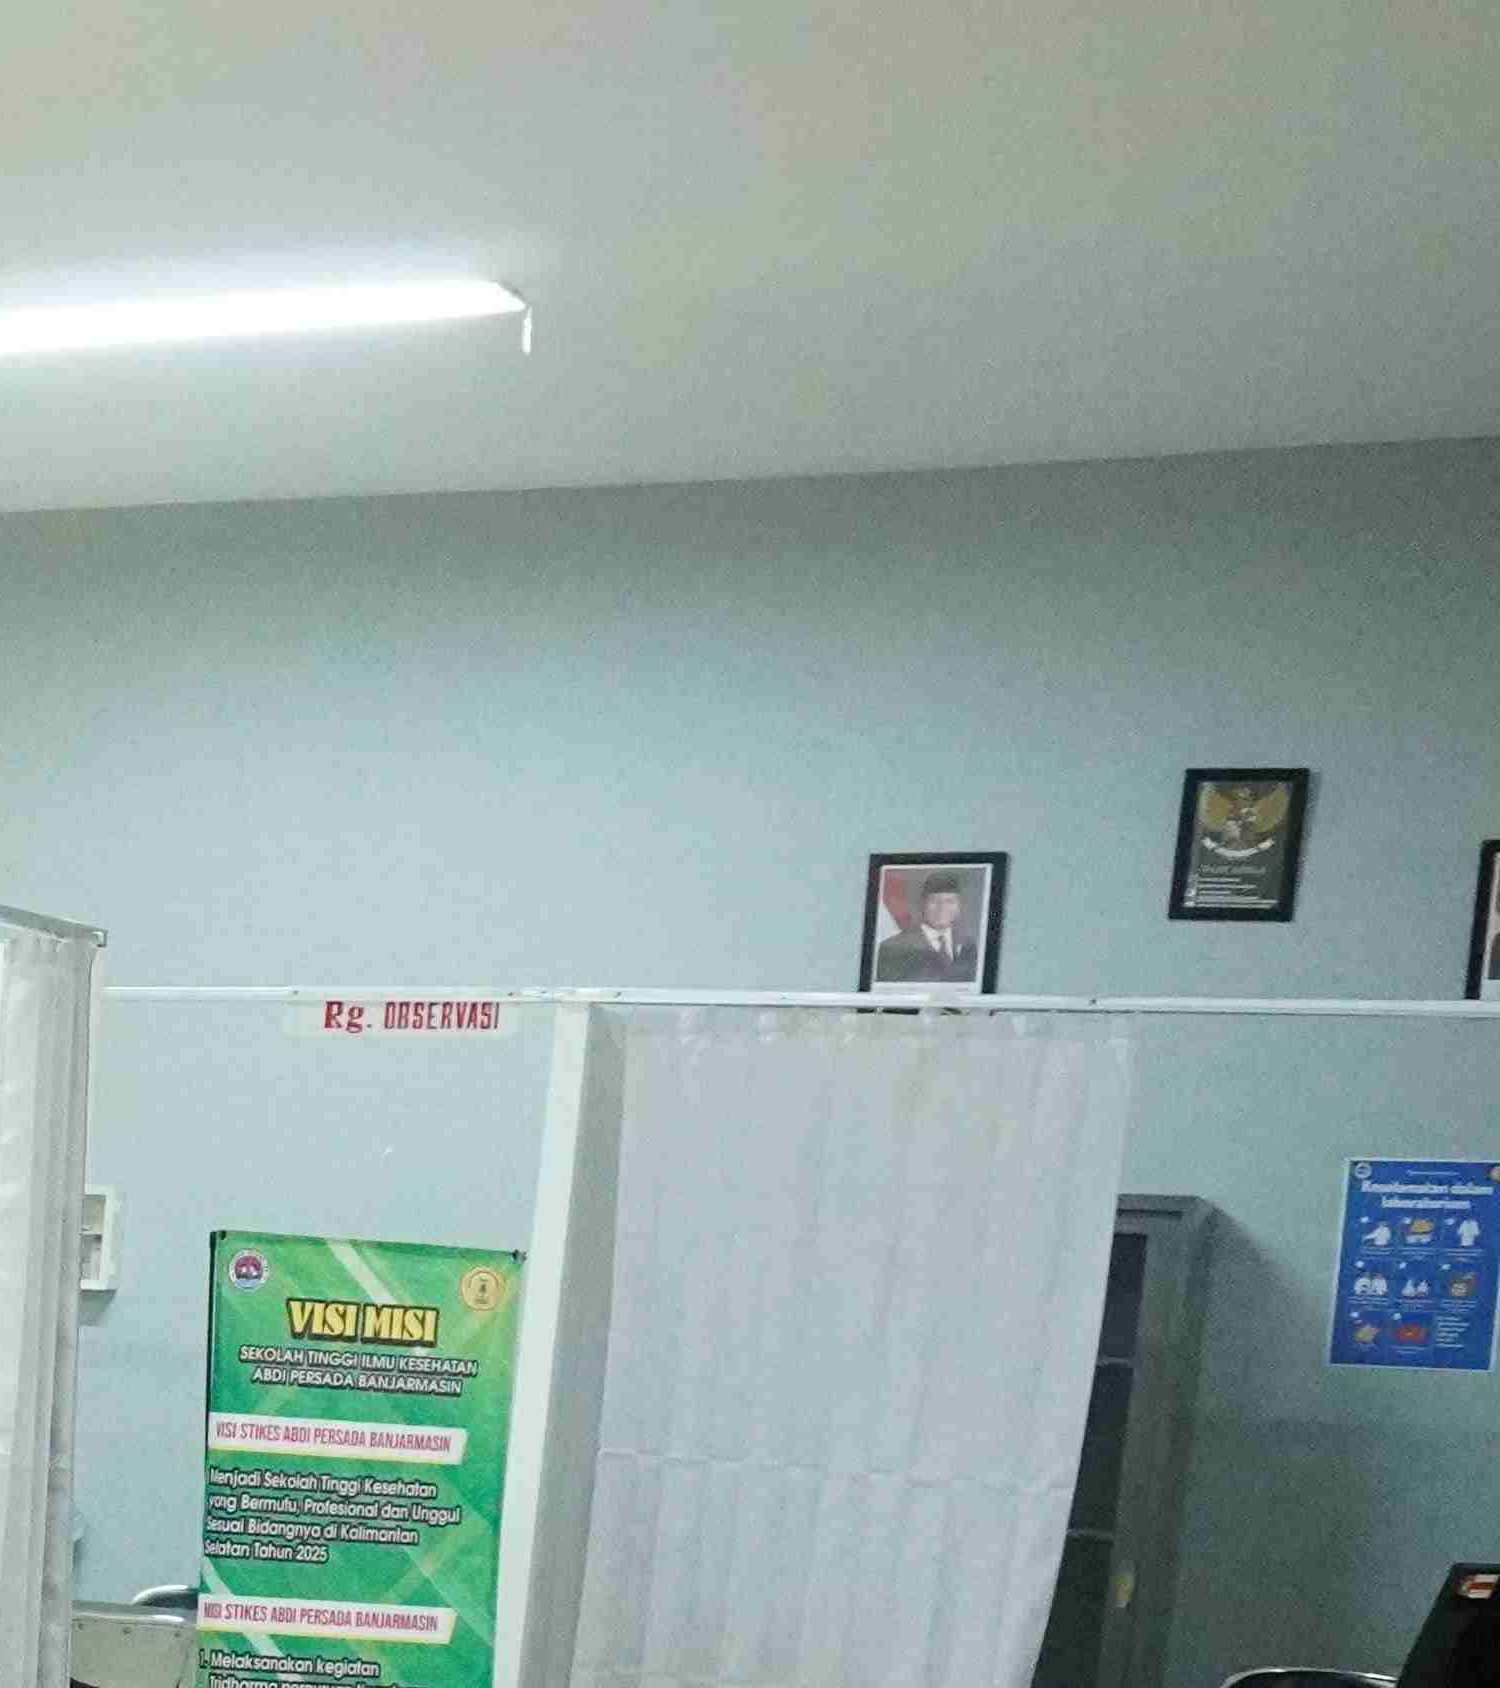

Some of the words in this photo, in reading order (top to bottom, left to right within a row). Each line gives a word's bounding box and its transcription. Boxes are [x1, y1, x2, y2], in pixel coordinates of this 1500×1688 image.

[324, 1001, 372, 1033] Rg.
[384, 1001, 500, 1029] OBSERVASI
[288, 1300, 359, 1339] VISI
[363, 1305, 438, 1344] MISI
[240, 1346, 303, 1363] SEKOLAH
[308, 1351, 358, 1366] TINGGI
[362, 1355, 396, 1369] ILMU
[400, 1357, 477, 1376] KESEHATAN
[253, 1368, 286, 1383] ABDI
[291, 1370, 354, 1386] PERSADA
[359, 1375, 462, 1393] BANJARMASIN
[240, 1423, 280, 1441] STIKES
[314, 1429, 365, 1446] PERSADA
[370, 1432, 451, 1451] BANJARMASIN
[264, 1472, 317, 1490] Sekolah
[365, 1480, 436, 1497] Kesehatan
[305, 1500, 377, 1516] Profesional
[382, 1504, 408, 1519] dan
[412, 1506, 460, 1525] Unggul
[324, 1524, 337, 1538] di
[341, 1524, 418, 1543] Kalimantan
[253, 1543, 293, 1559] Tahun
[296, 1545, 328, 1562] 2025
[225, 1604, 267, 1622] STIKES
[300, 1609, 351, 1626] PERSADA
[356, 1611, 438, 1631] BANJARMASIN
[211, 1651, 312, 1673] Melaksanakan
[317, 1657, 379, 1677] kegiatan
